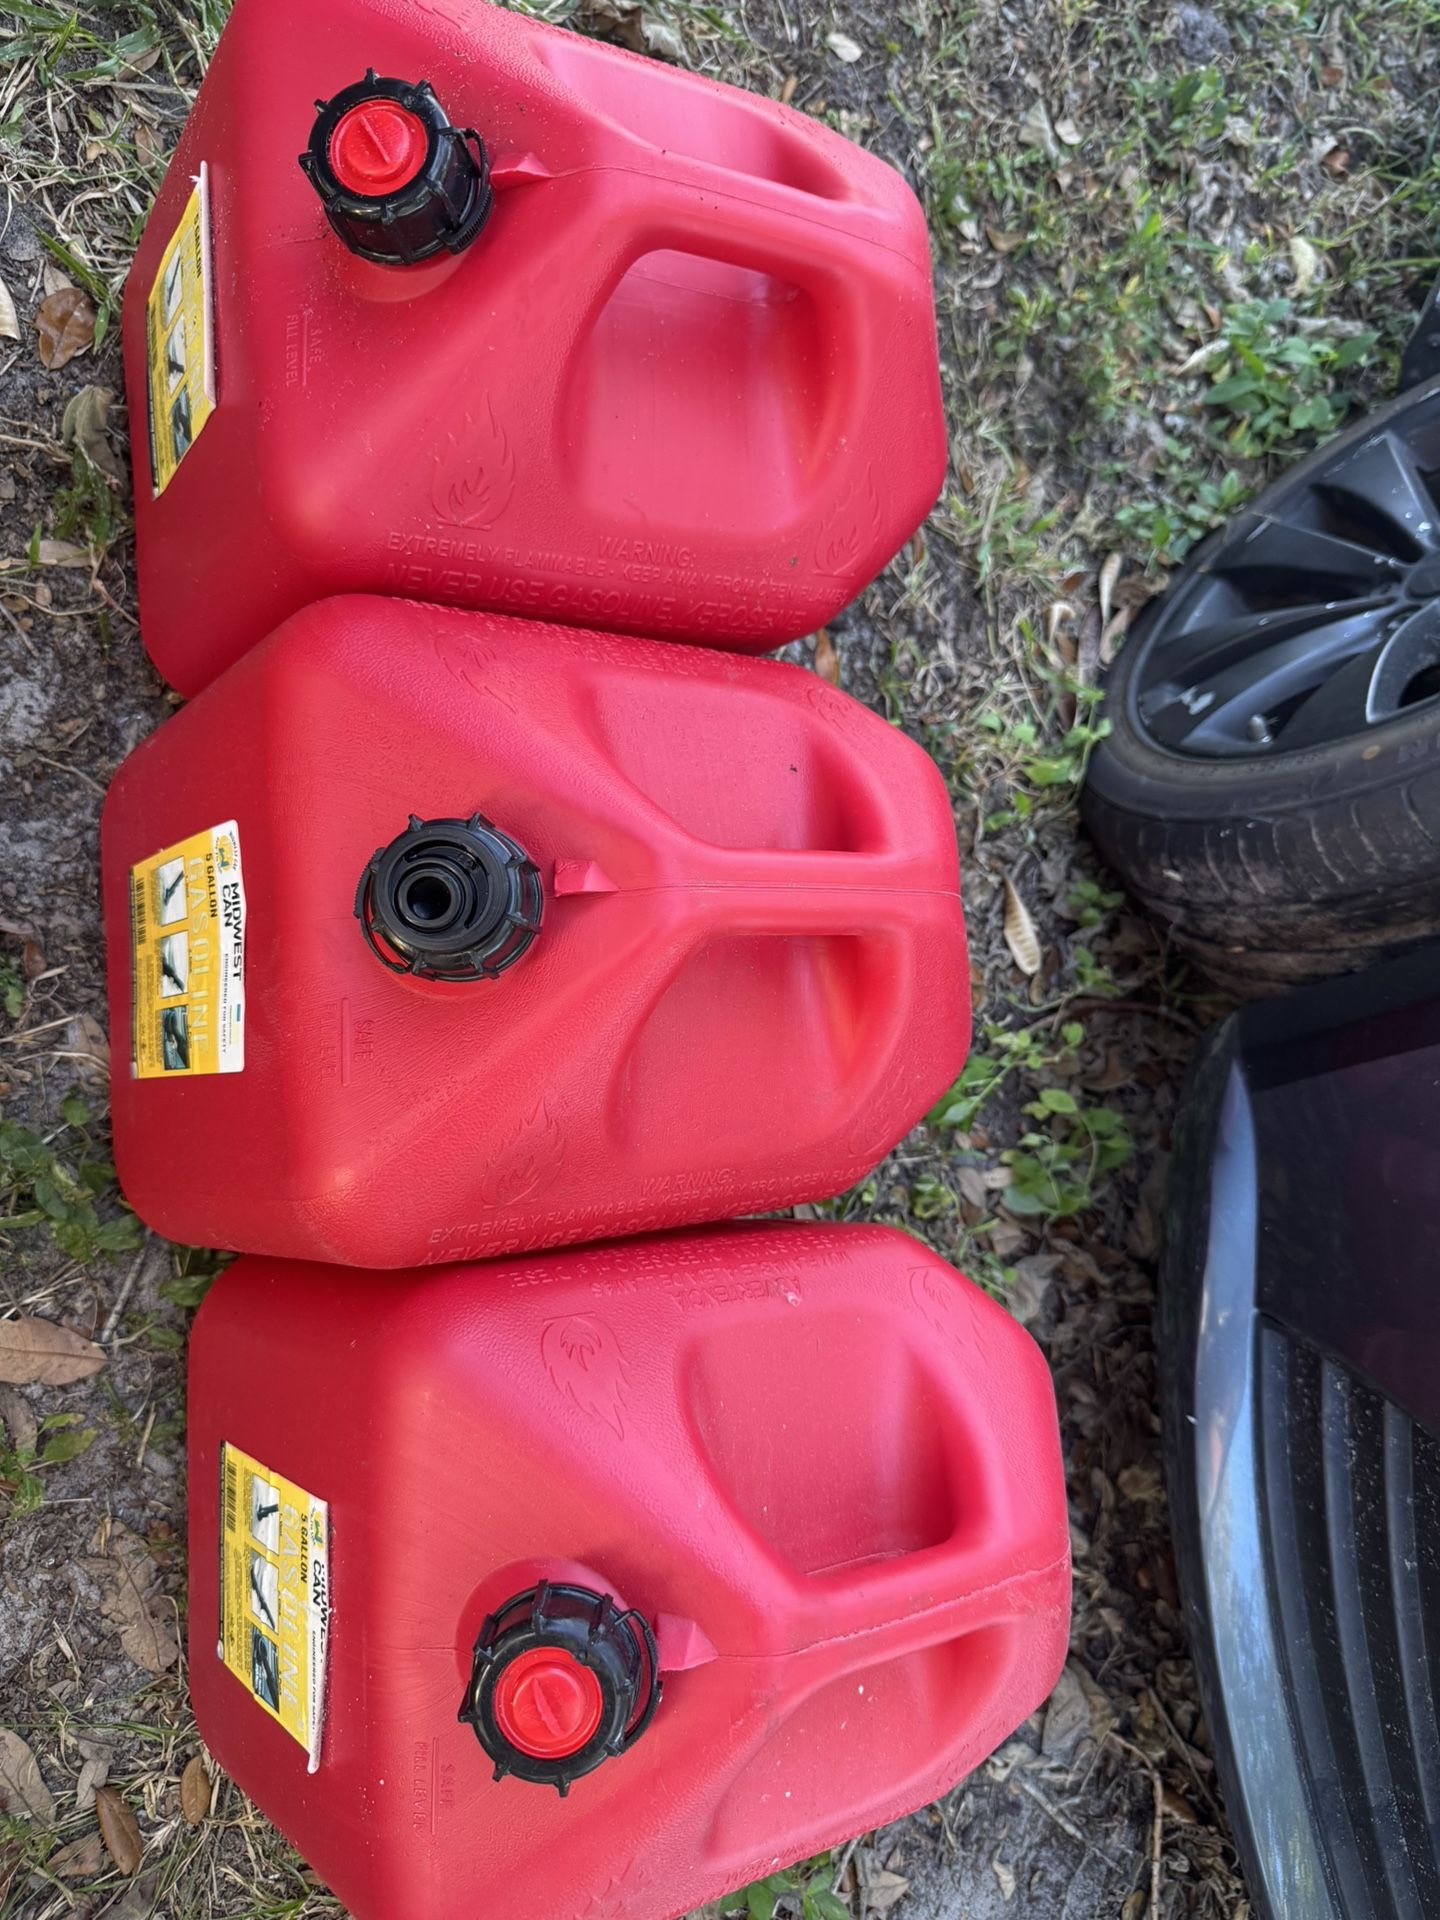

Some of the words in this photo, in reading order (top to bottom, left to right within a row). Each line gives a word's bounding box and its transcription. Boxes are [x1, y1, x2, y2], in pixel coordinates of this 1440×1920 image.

[194, 226, 202, 279] GALLON
[286, 313, 300, 340] FILL
[309, 327, 323, 363] SAFE
[285, 343, 299, 389] LEVEL
[387, 531, 500, 563] EXTREMELY
[503, 548, 607, 577] FLAMMABLE
[621, 562, 661, 583] KEEP
[664, 569, 710, 591] AWAY
[713, 575, 754, 593] FROM
[758, 577, 798, 599] OPEN
[600, 535, 698, 568] WARNING:
[382, 563, 483, 595] NEVER
[485, 575, 545, 605] USE
[205, 852, 214, 862] 5
[206, 865, 218, 918] GALLON
[222, 884, 233, 928] CAN
[230, 881, 243, 981] MIDWEST
[187, 857, 210, 1056] GASOLINE
[222, 952, 230, 1005] ENGINEERED
[353, 1019, 375, 1064] SAFE
[642, 1168, 736, 1194] WARNING:
[428, 1213, 541, 1244] EXTREMELY
[543, 1198, 647, 1227] FLAMMABLE
[300, 1513, 308, 1523] 5
[300, 1526, 308, 1584] GALLON
[281, 1503, 300, 1706] GASOLINE
[312, 1559, 322, 1607] CAN
